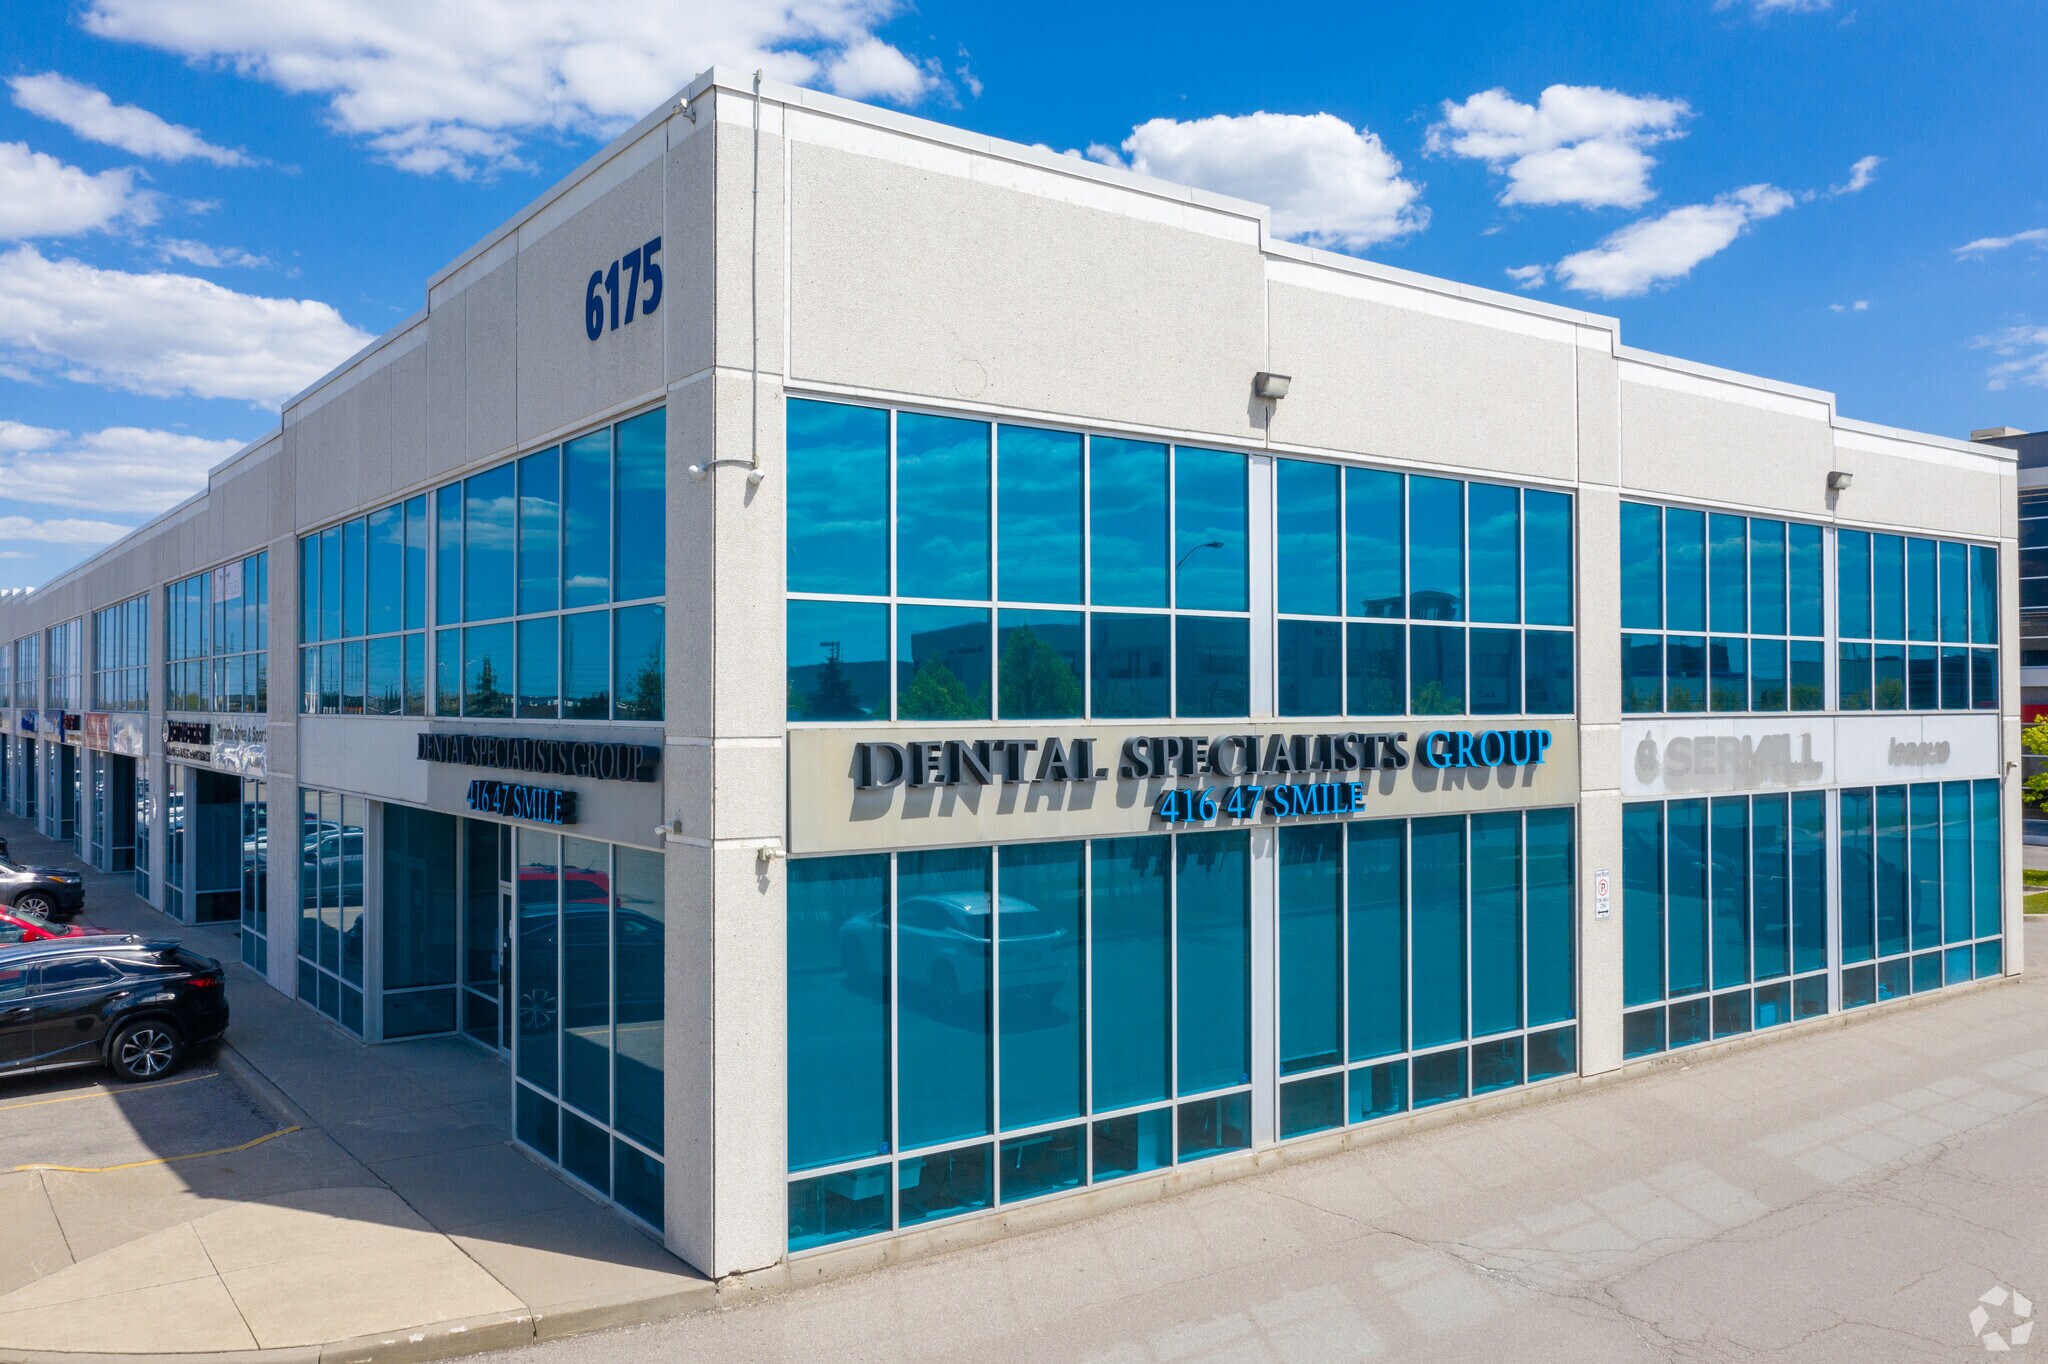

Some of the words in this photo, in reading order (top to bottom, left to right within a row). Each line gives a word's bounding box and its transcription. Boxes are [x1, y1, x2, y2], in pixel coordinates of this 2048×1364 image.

[586, 236, 663, 341] 6175
[417, 733, 468, 764] DENTAL
[471, 736, 569, 776] SPECIALISTS
[572, 742, 646, 782] GROUP
[856, 736, 1109, 790] DENTAL
[1121, 731, 1410, 778] SPECIALISTS
[1421, 729, 1552, 769] GROUP
[466, 780, 490, 813] 416
[493, 784, 509, 816] 47
[512, 785, 564, 825] SMILE
[1158, 786, 1217, 823] 416
[1226, 785, 1263, 820] 47
[1270, 781, 1366, 818] SMILE
